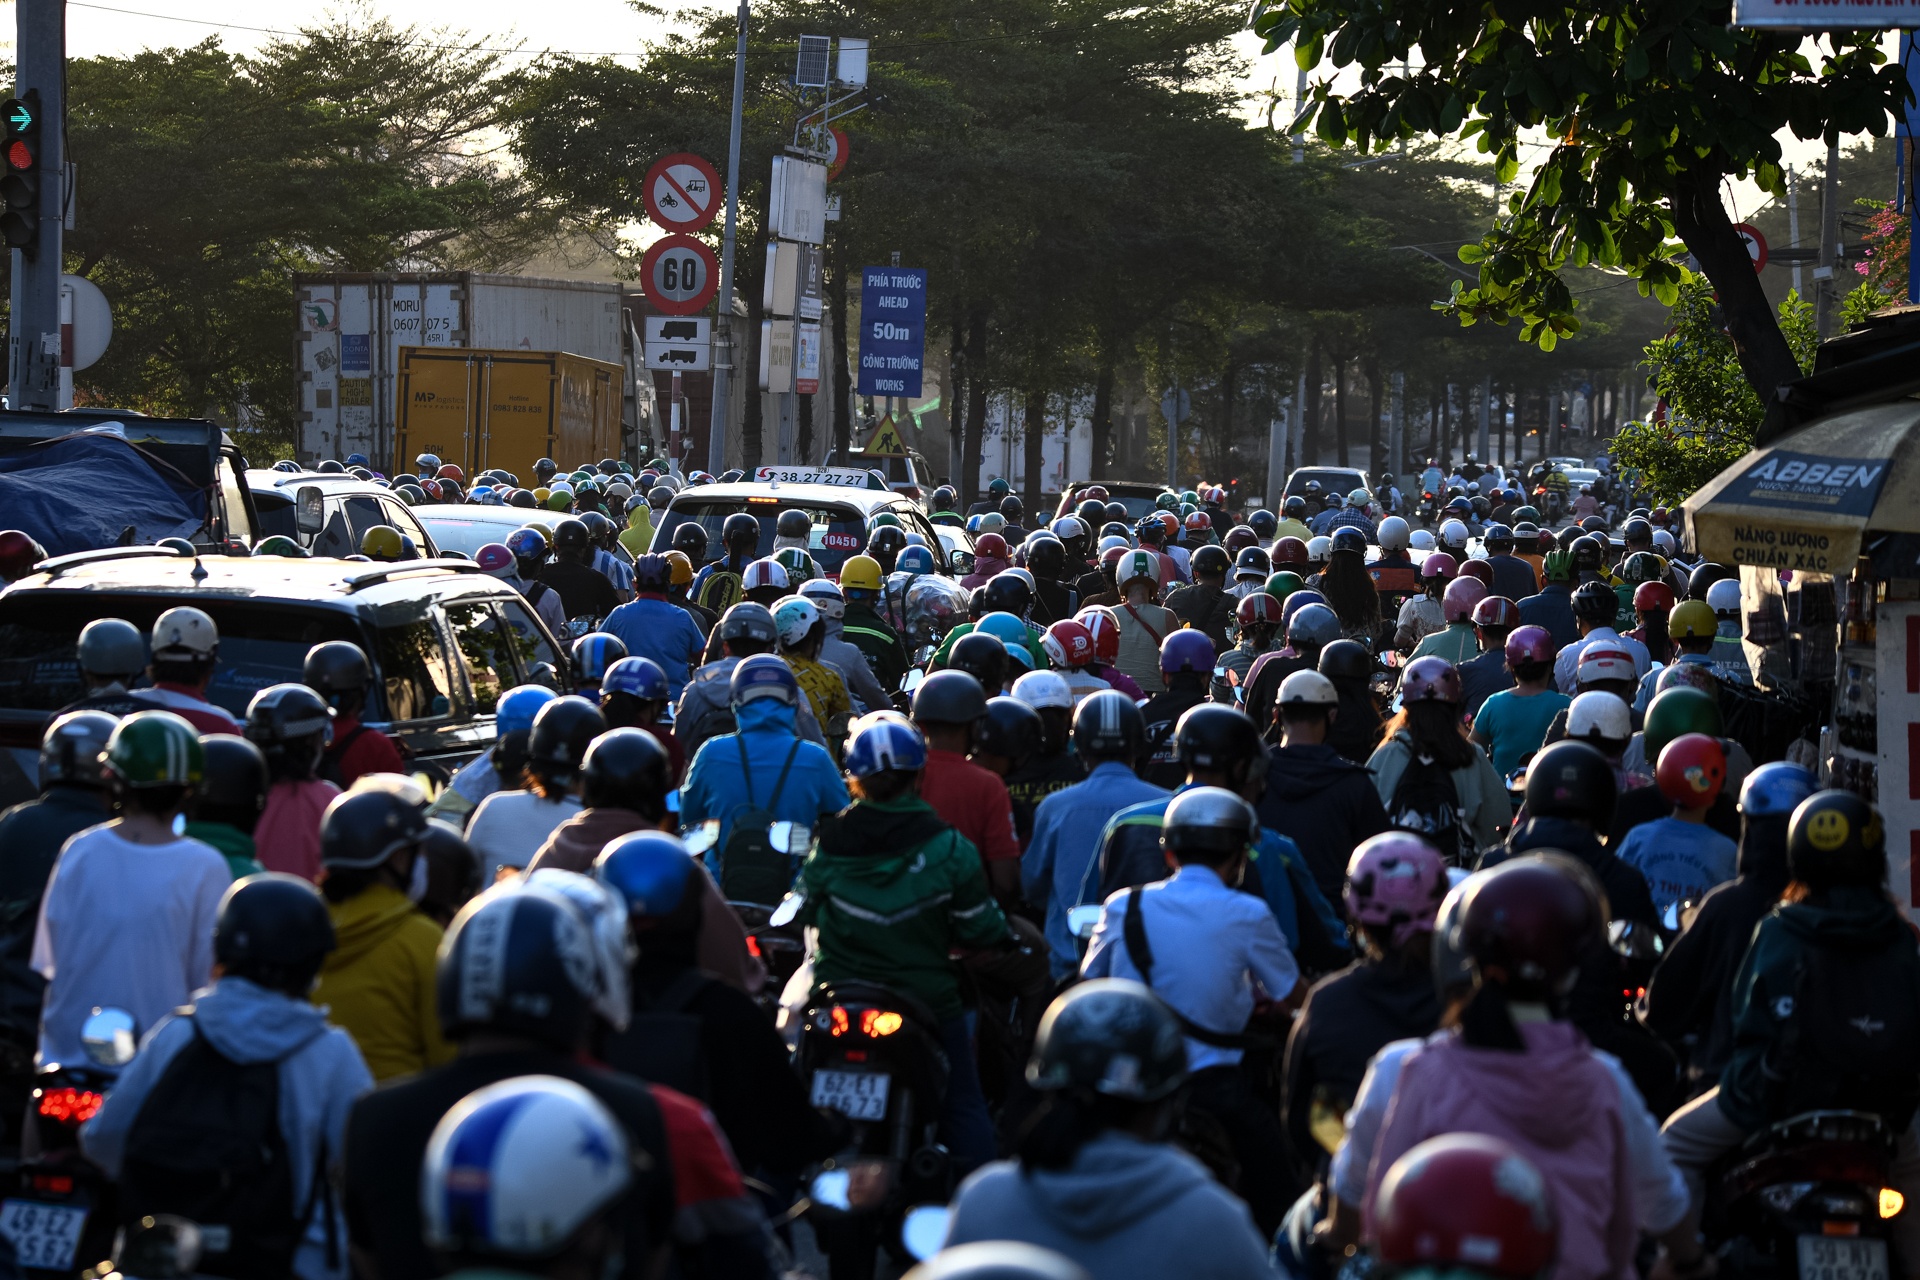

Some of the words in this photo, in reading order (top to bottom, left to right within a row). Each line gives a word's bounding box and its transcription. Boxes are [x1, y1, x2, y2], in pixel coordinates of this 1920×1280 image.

[663, 258, 696, 291] 60
[868, 273, 889, 287] PHÍA
[891, 274, 921, 289] TRƯỚC
[393, 300, 420, 312] MORU
[878, 296, 909, 309] AHEAD
[393, 318, 420, 330] 0607
[873, 322, 910, 340] 50m
[863, 353, 885, 368] CÔNG
[887, 355, 919, 370] TRƯỜNG
[340, 380, 371, 388] CAUTION
[875, 379, 904, 392] WORKS
[347, 388, 364, 396] HIGH
[340, 397, 371, 406] TRAILER
[1748, 457, 1882, 488] ABBEN
[823, 534, 857, 548] 10450
[1734, 524, 1776, 544] NĂNG
[1780, 530, 1830, 551] LƯỢNG
[1733, 546, 1789, 566] CHUẨN
[1794, 551, 1828, 571] XÁC
[786, 567, 808, 580] Grab
